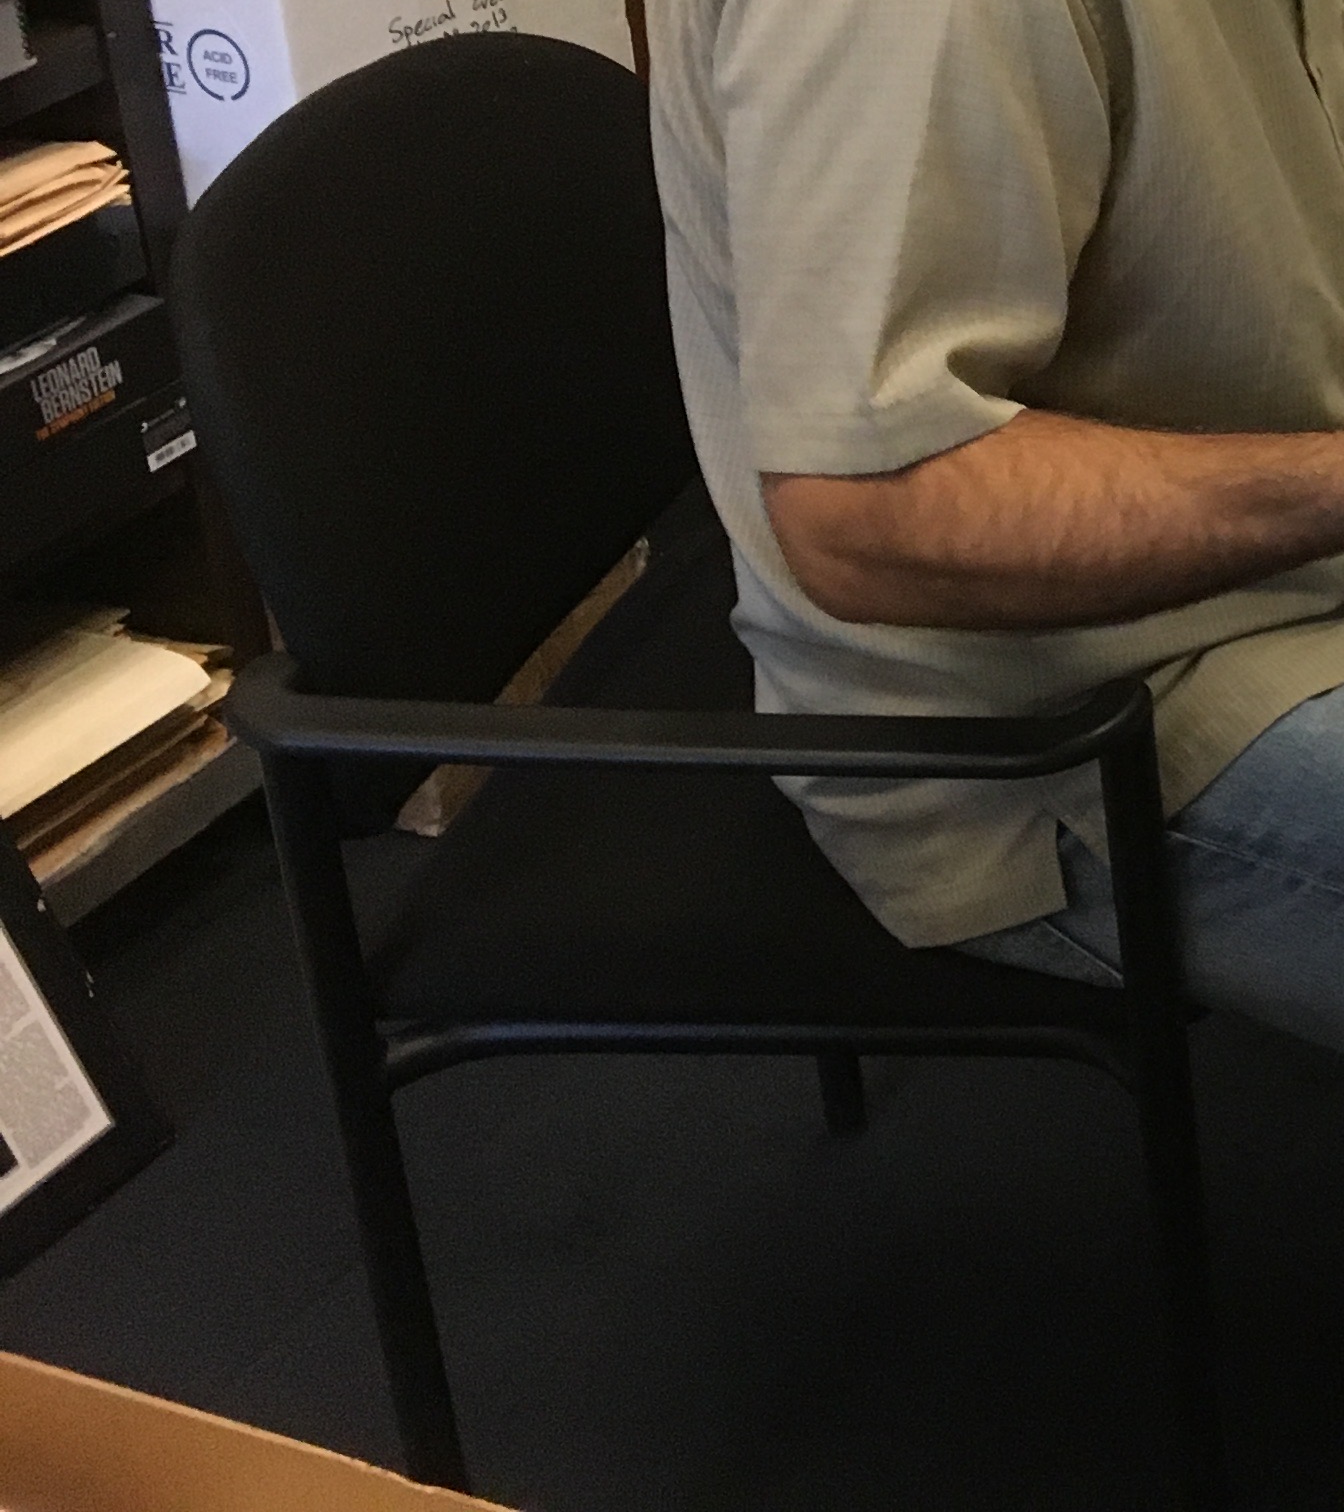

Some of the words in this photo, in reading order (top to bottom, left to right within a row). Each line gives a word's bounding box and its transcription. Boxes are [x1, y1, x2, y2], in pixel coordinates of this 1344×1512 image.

[387, 0, 456, 45] Special
[202, 49, 233, 65] ACID
[205, 68, 239, 85] FREE
[30, 347, 101, 401] LEONARD
[40, 360, 123, 424] BERNSTEIN
